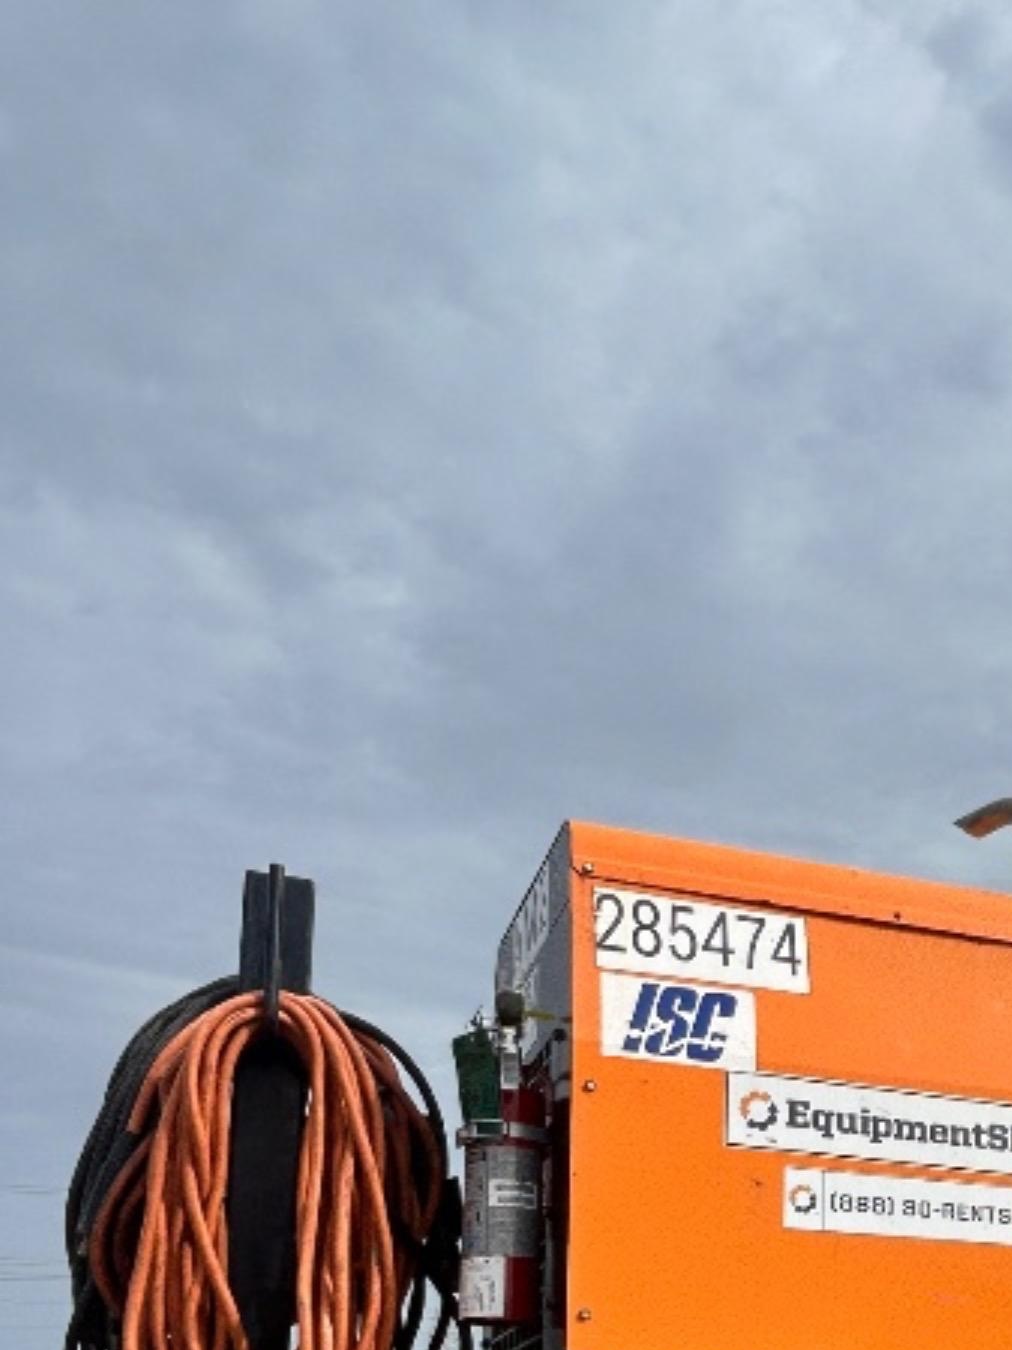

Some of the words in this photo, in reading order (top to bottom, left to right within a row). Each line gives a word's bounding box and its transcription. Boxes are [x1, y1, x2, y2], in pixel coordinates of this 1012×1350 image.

[595, 894, 802, 975] 285474
[621, 983, 738, 1061] ISC
[829, 1192, 895, 1216] (888)
